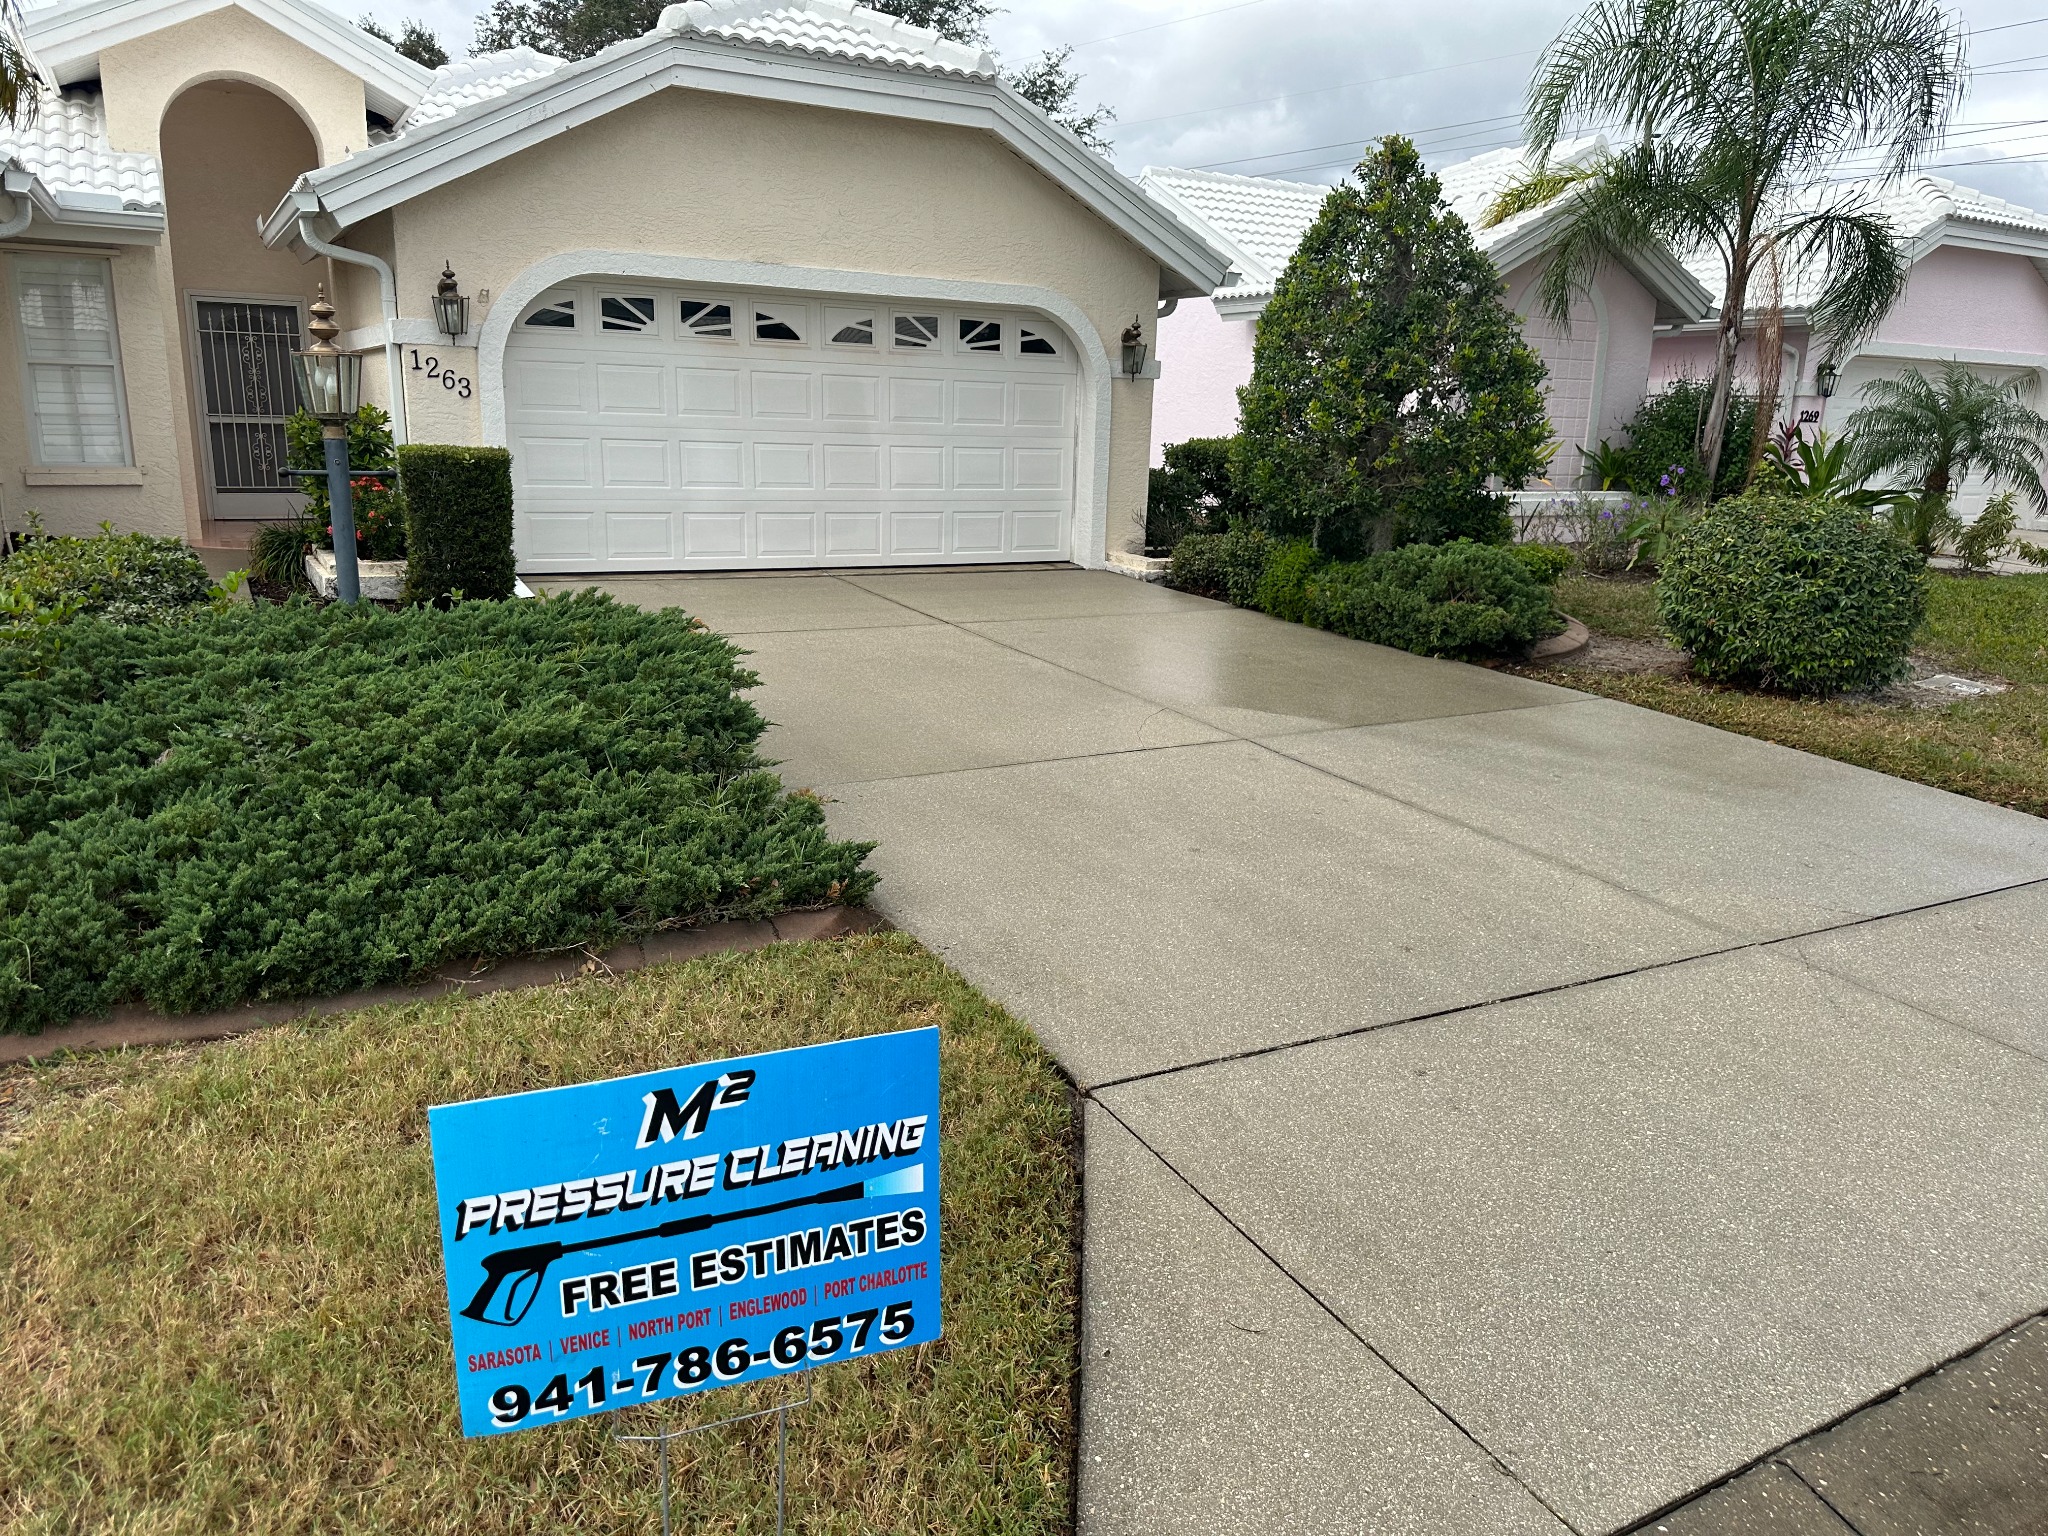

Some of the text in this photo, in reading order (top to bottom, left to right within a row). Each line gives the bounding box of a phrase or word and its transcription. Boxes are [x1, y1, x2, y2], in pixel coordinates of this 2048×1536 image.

[411, 349, 472, 399] 1263
[1800, 410, 1820, 423] 1269
[455, 1114, 929, 1241] PRESSURE CLEANING
[468, 1261, 928, 1373] SARASOTA VENICE NORTH PORT ENGLEWOOD PORT CHARLOTTE
[560, 1207, 927, 1318] FREE ESTIMATES
[488, 1300, 915, 1428] 941-786-6575
